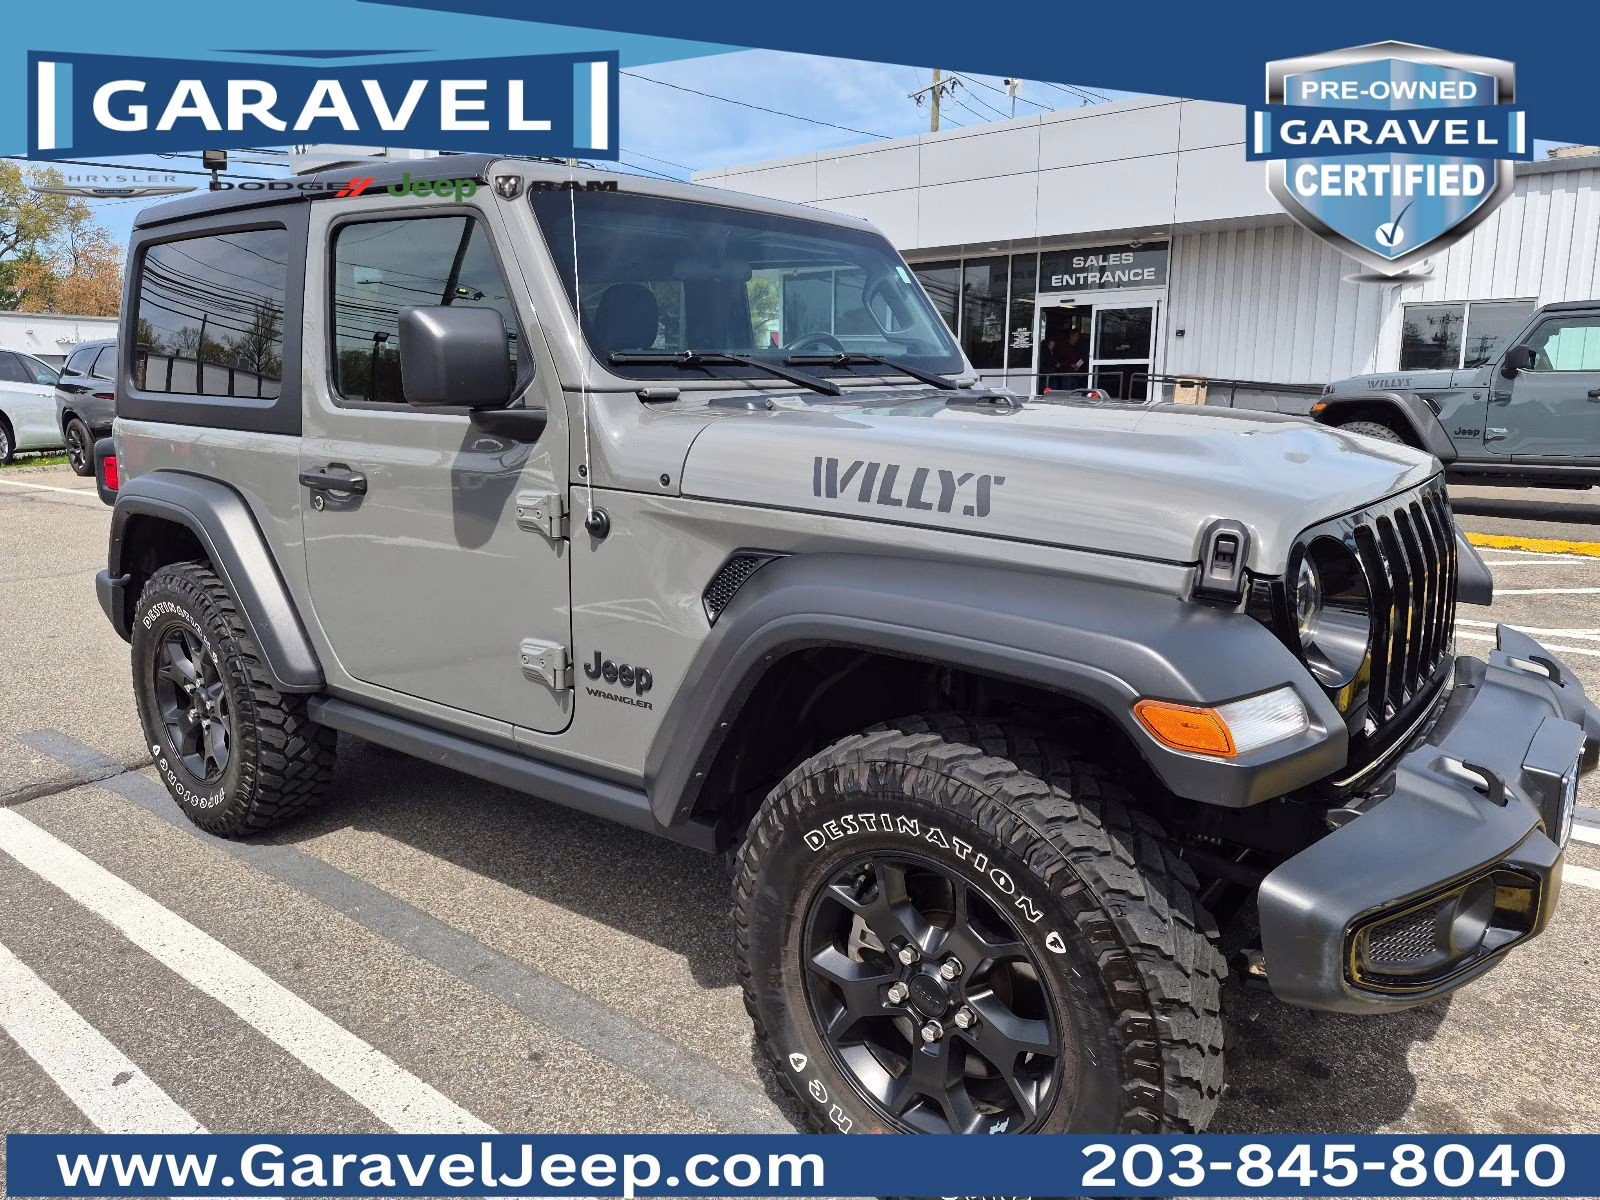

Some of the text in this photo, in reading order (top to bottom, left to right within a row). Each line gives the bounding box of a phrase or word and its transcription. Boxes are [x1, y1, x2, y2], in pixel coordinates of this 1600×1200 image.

[1072, 252, 1134, 268] SALES
[1051, 267, 1156, 287] ENTRANCE
[1367, 378, 1413, 389] WILLYS
[1454, 427, 1480, 437] Jeep
[812, 456, 1006, 518] WILLYS
[584, 650, 653, 696] Jeep
[585, 686, 653, 711] WRANGLER
[804, 813, 1044, 923] DESTINATION
